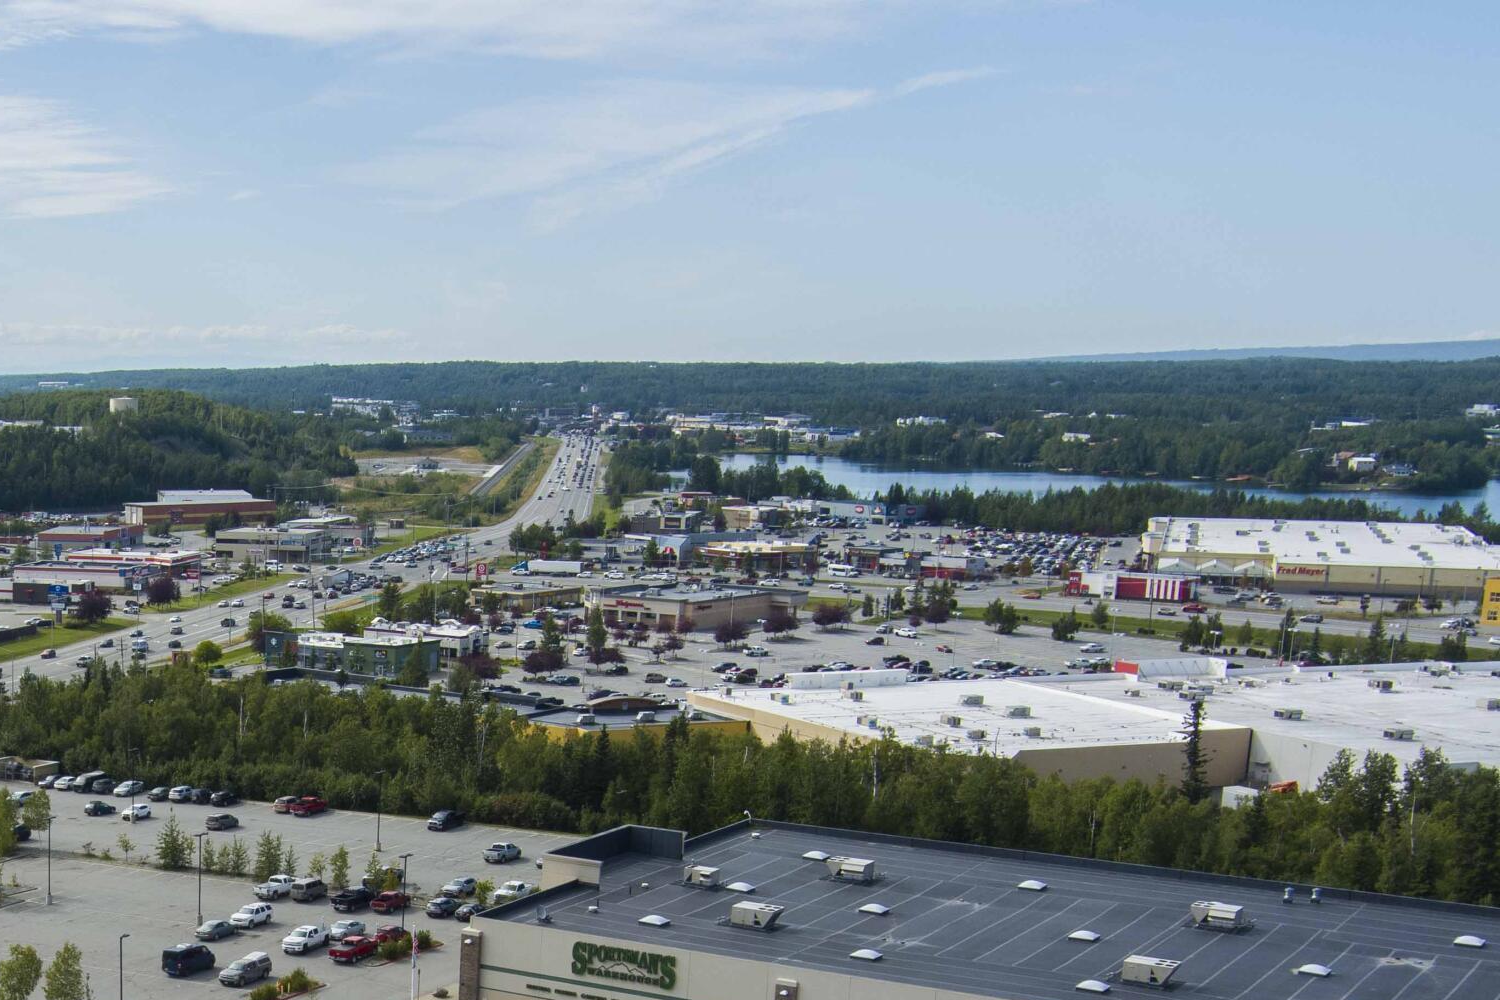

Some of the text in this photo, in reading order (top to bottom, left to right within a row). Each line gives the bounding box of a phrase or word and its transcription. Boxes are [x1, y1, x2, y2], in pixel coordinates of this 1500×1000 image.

[1277, 566, 1324, 576] Fred Meyer
[571, 941, 676, 990] SPORTSMAN'S
[587, 967, 660, 986] WAREHOUSE
